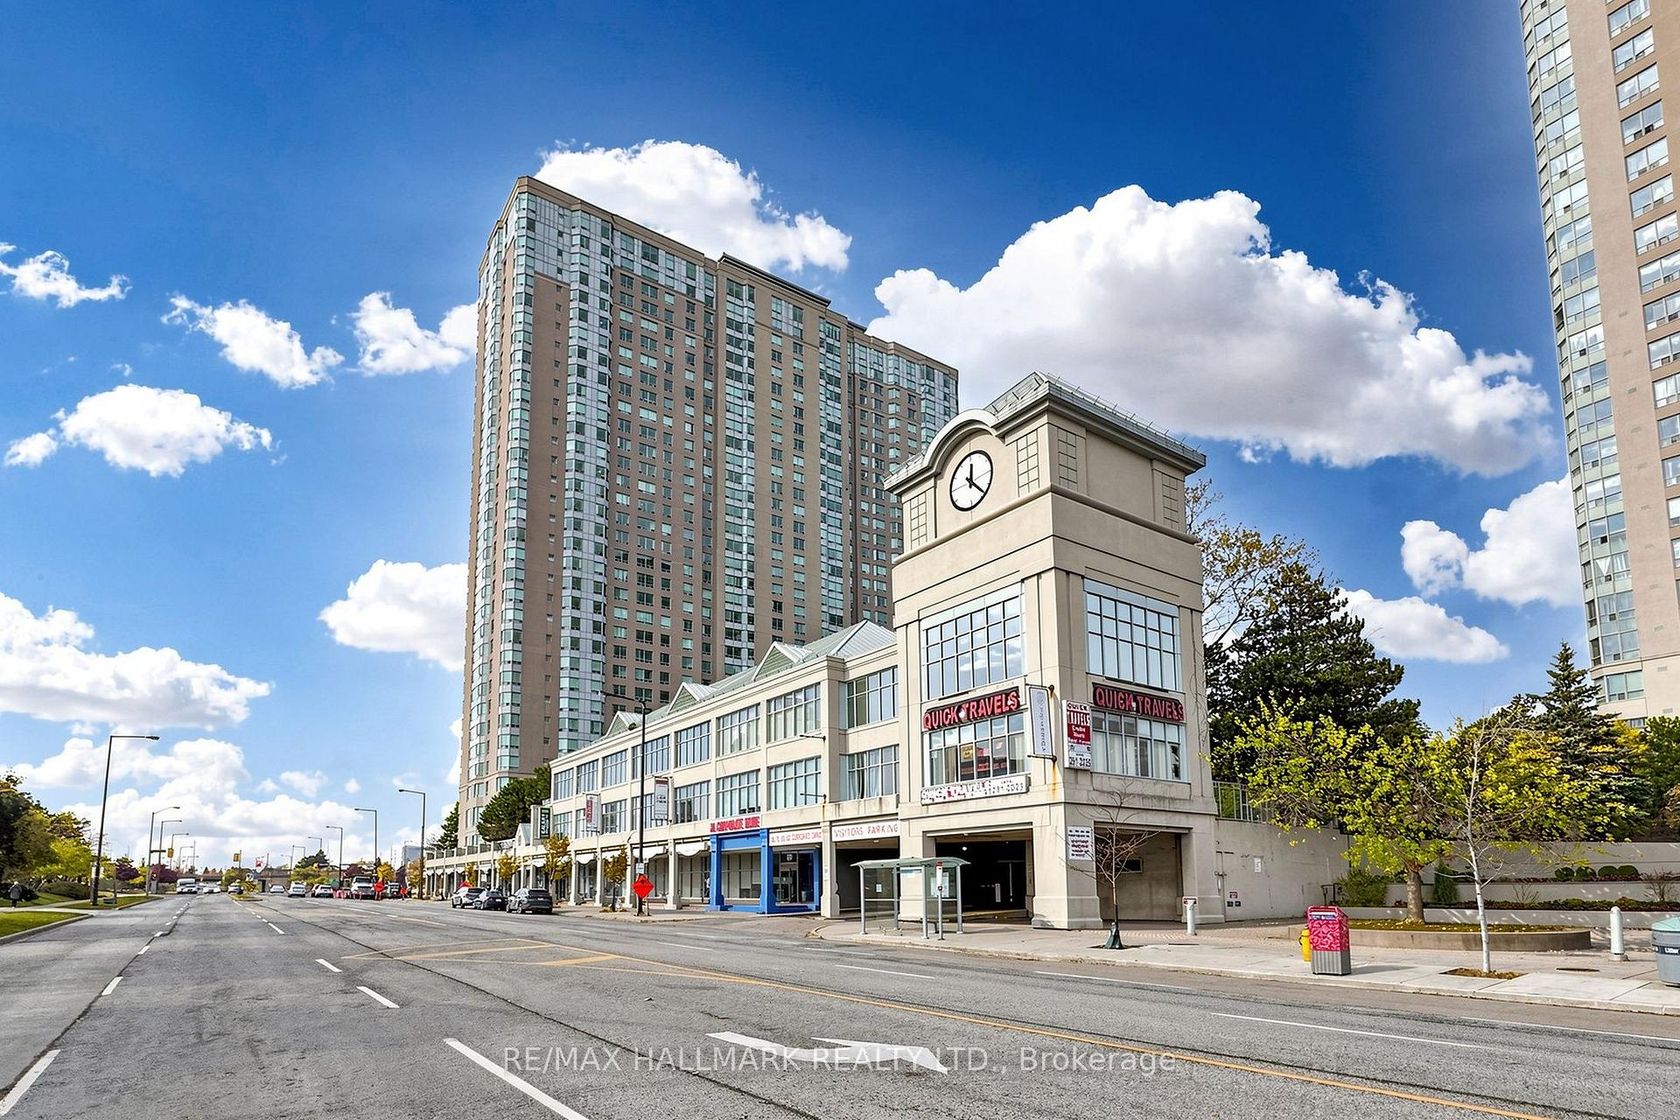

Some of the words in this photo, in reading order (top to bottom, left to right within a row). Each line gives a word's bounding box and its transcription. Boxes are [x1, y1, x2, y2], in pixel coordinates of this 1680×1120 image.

[922, 706, 958, 731] QUICK
[961, 691, 1018, 720] TRAVELS
[1096, 687, 1133, 711] QUICK
[1137, 695, 1185, 721] TRAVELS
[832, 827, 863, 838] VISITORS
[867, 823, 898, 835] PARKING
